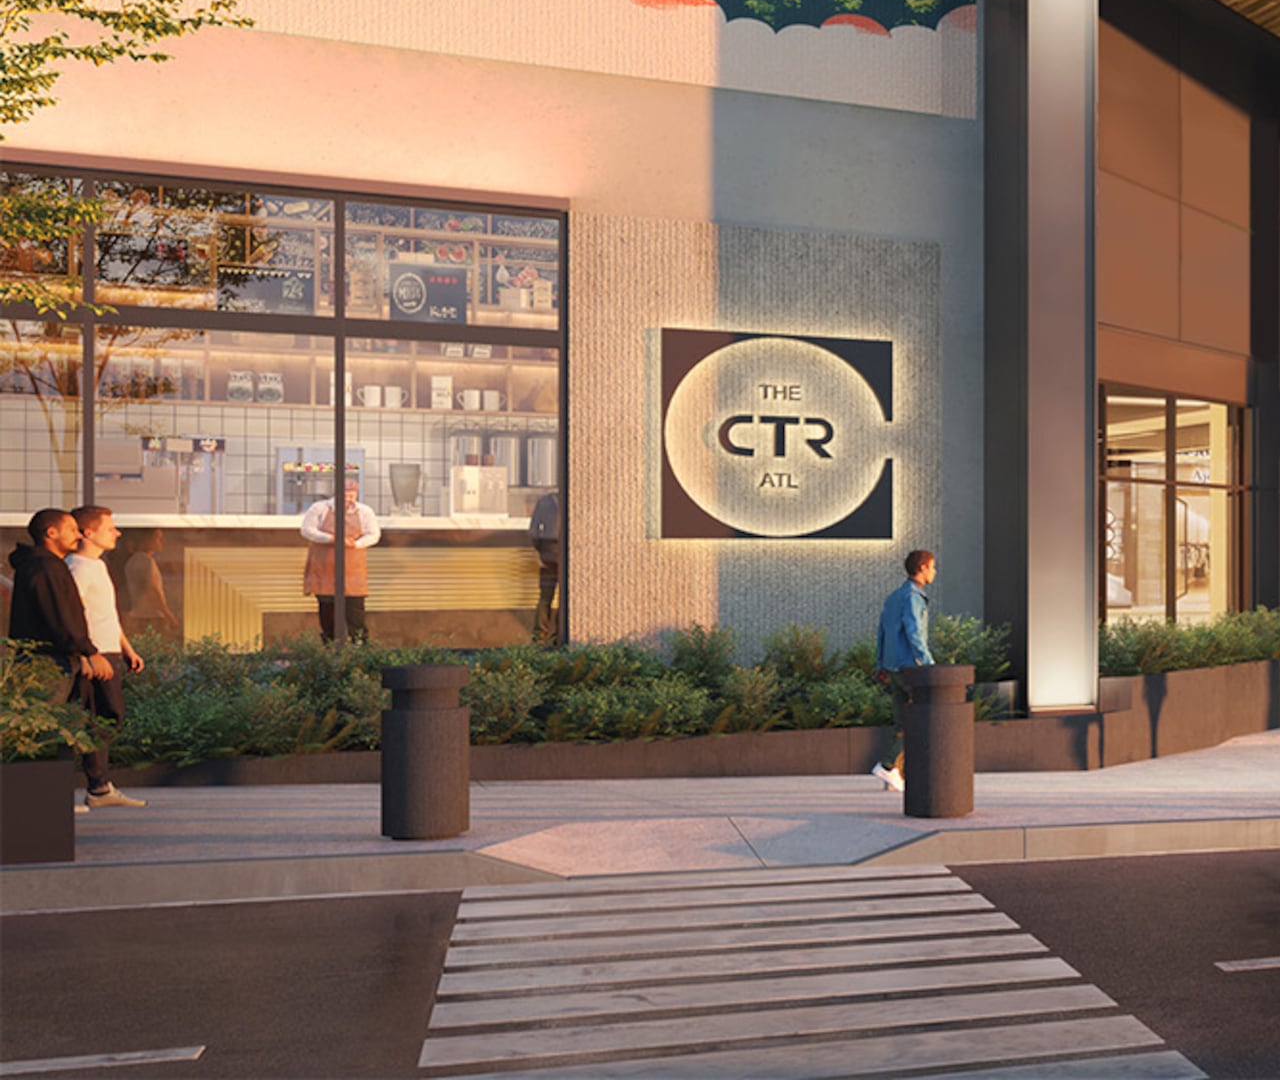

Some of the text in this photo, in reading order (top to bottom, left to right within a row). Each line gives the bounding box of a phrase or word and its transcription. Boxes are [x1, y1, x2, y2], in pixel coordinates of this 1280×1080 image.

[758, 384, 802, 401] THE
[717, 413, 835, 460] CTR
[759, 472, 800, 489] ATL
